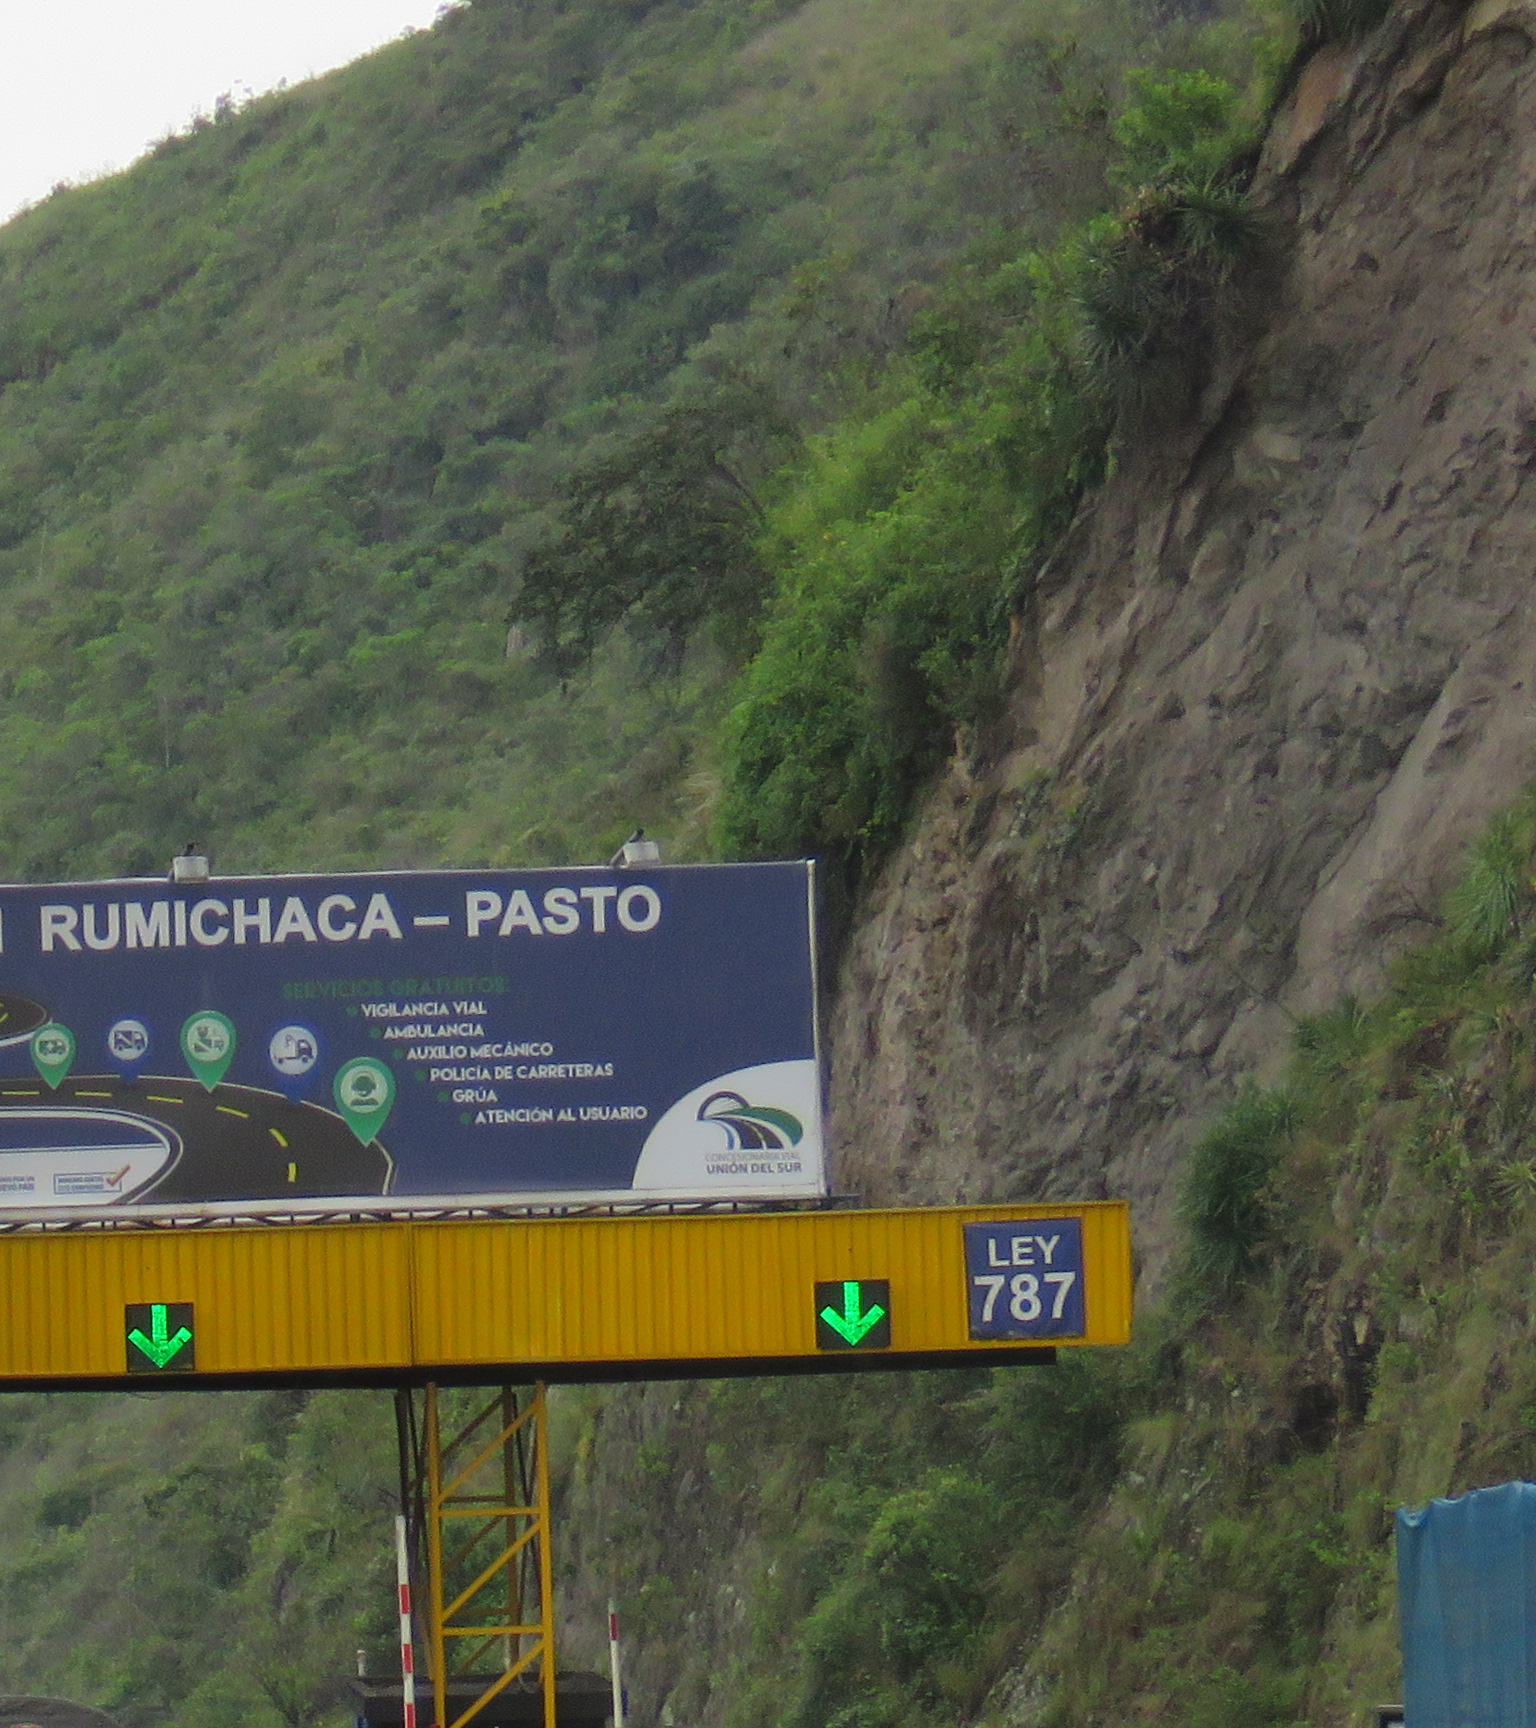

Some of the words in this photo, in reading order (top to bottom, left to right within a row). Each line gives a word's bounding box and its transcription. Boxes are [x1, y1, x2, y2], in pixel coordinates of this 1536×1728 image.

[39, 893, 403, 951] RUMICHACA
[465, 884, 663, 937] PASTO
[361, 1002, 450, 1018] VIGILANCIA
[453, 1001, 487, 1015] VIAL
[383, 1023, 485, 1039] AMBULANCIA
[407, 1045, 468, 1060] AUXILIO
[470, 1041, 554, 1059] MECÁNICO
[430, 1064, 492, 1082] POLICÍA
[495, 1065, 513, 1080] DE
[516, 1062, 614, 1079] CARRETERAS
[452, 1086, 499, 1104] GRÚA
[474, 1106, 553, 1124] ATENCIÓN
[556, 1108, 576, 1122] AL
[579, 1105, 649, 1121] USUARIO
[706, 1161, 749, 1175] UNIÓN
[751, 1163, 775, 1174] DEL
[777, 1162, 803, 1174] SUR
[988, 1234, 1061, 1268] LEY
[973, 1271, 1077, 1323] 787
